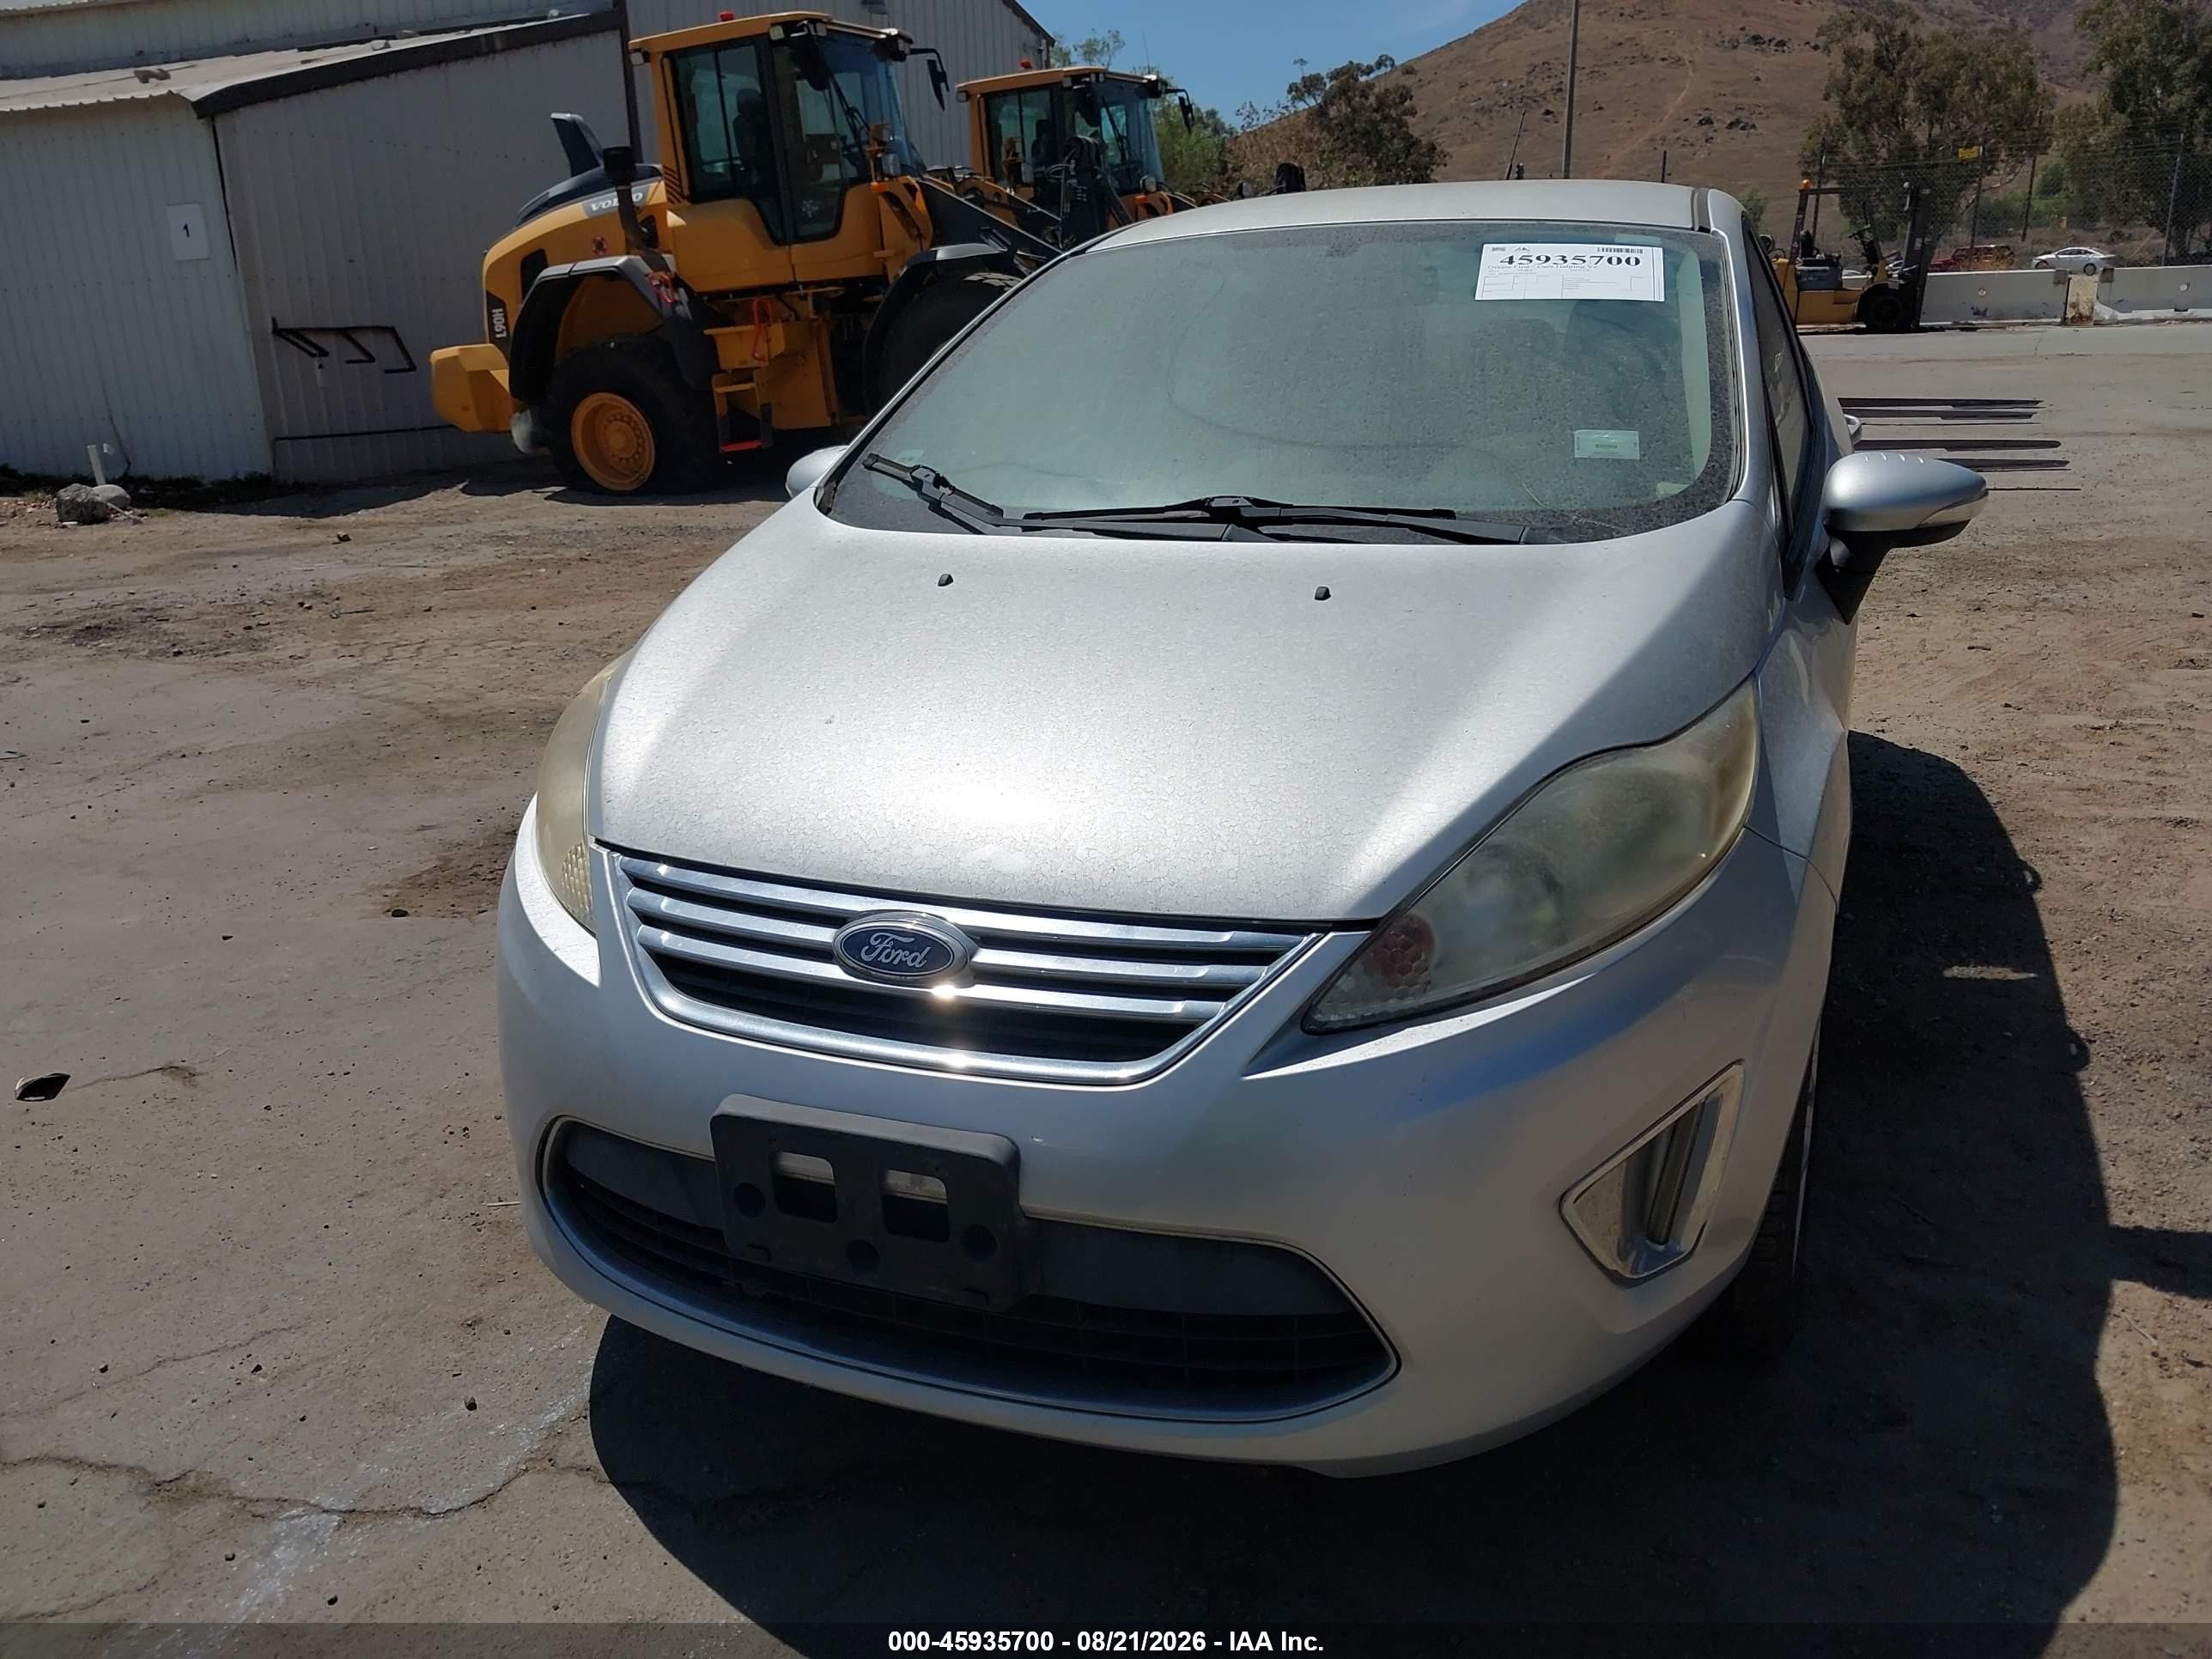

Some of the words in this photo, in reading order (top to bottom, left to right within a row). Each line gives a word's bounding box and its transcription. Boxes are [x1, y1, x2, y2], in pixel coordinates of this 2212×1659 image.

[591, 192, 643, 211] VOLO
[183, 223, 190, 238] 1
[1499, 254, 1641, 267] 45935700
[491, 308, 507, 338] L90H
[860, 932, 932, 968] Ford
